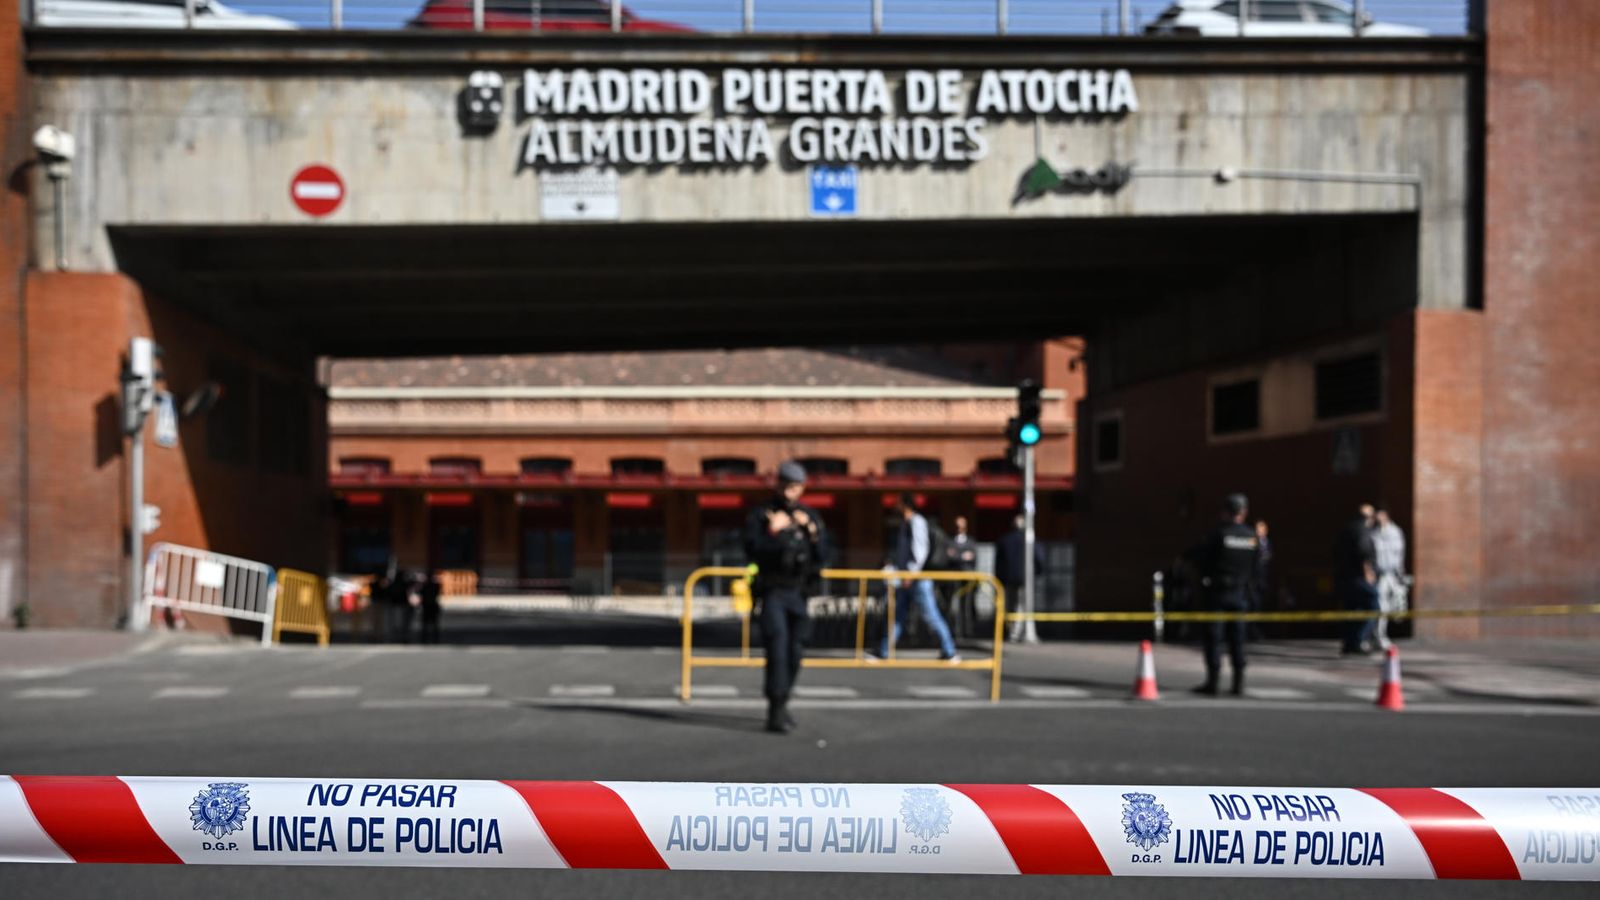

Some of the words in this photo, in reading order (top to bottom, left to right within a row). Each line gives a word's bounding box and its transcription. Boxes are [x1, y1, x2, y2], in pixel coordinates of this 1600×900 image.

[523, 68, 711, 114] MADRID
[722, 68, 890, 114] PUERTA
[906, 68, 963, 114] DE
[976, 68, 1139, 114] ATOCHA
[525, 117, 776, 164] ALMUDENA
[789, 117, 988, 161] GRANDES
[307, 783, 353, 807] NO
[360, 784, 457, 808] PASAR
[1209, 794, 1251, 821] NO
[1252, 795, 1341, 822] PASAR
[202, 842, 239, 851] D.G.P.
[252, 816, 337, 852] LINEA
[348, 817, 384, 853] DE
[396, 817, 503, 854] POLICIA
[1174, 829, 1245, 864] LINEA
[1253, 830, 1287, 865] DE
[1294, 831, 1385, 866] POLICIA
[1131, 854, 1162, 863] D.G.P.
